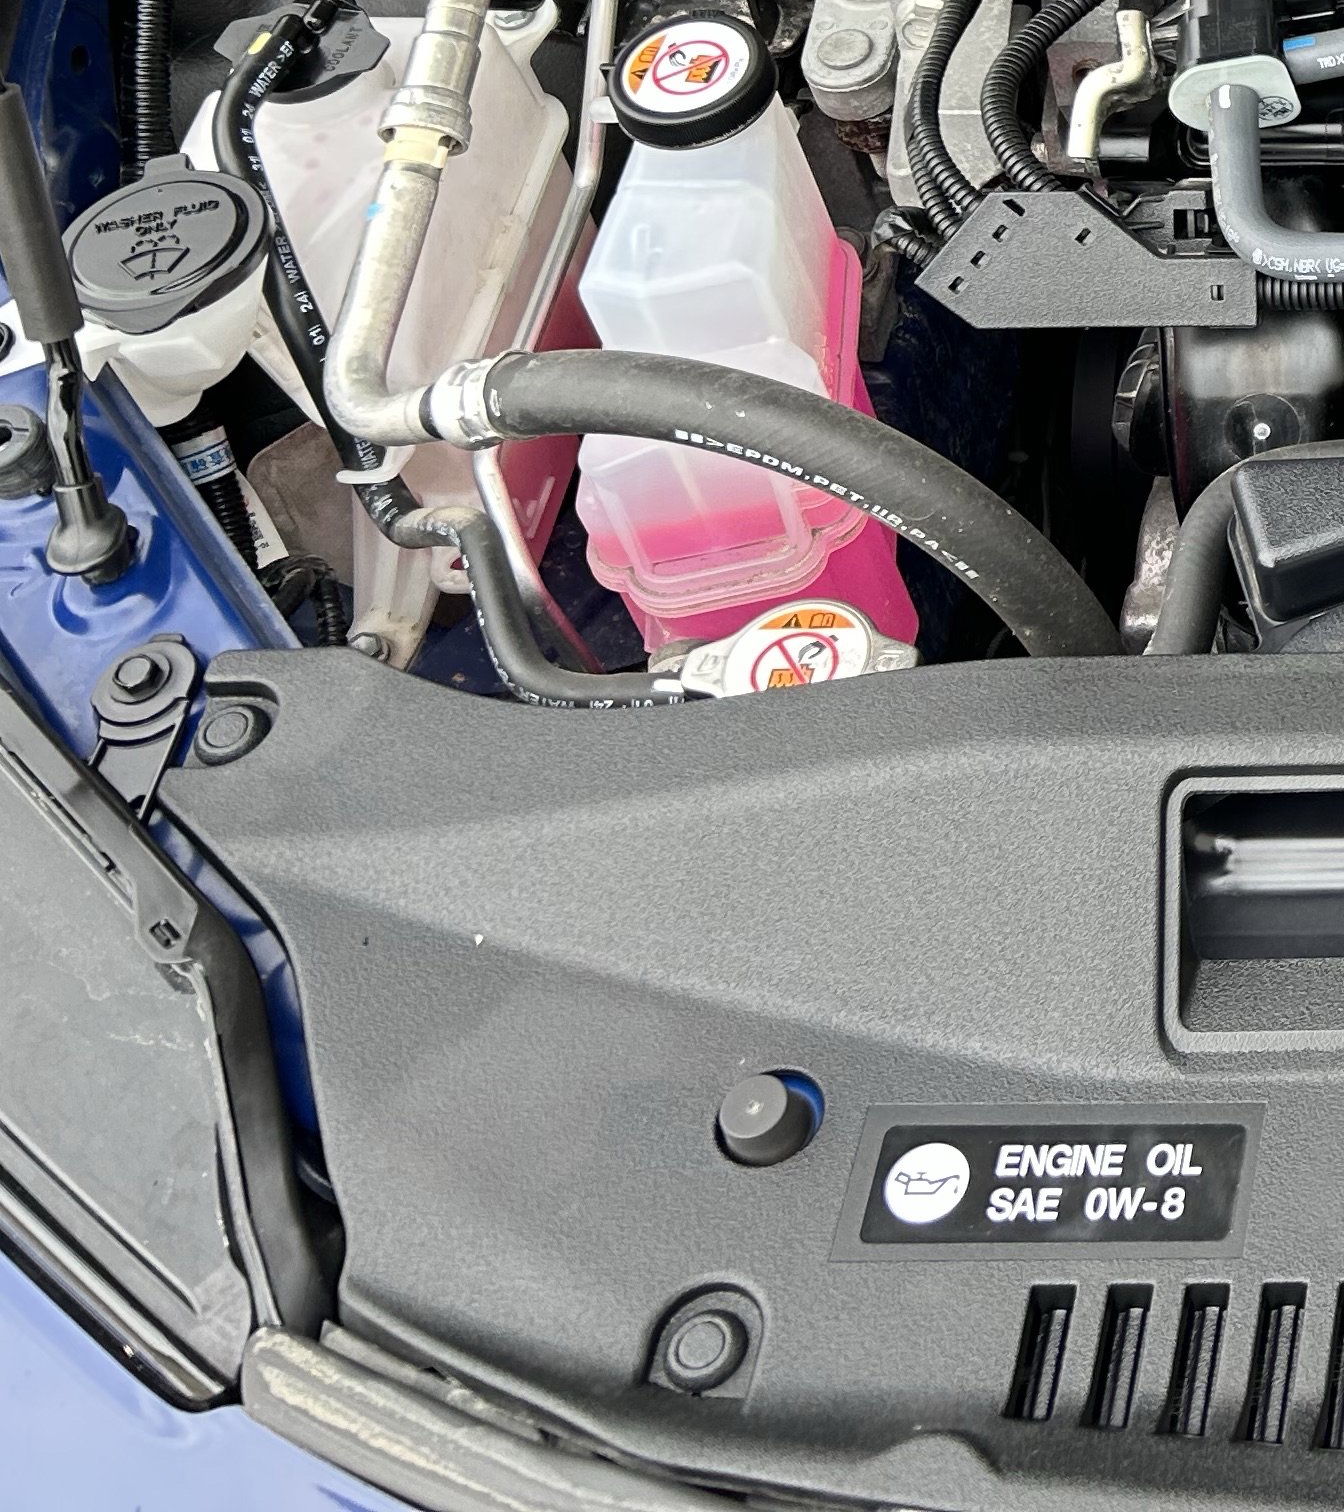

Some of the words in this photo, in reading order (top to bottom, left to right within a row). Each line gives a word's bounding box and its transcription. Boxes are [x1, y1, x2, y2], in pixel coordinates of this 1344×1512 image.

[324, 25, 363, 72] COOLANT
[248, 62, 282, 98] WATER
[94, 210, 164, 235] WASHER
[173, 199, 221, 217] FLUID
[135, 219, 178, 238] ONLY
[273, 236, 302, 284] WATER
[994, 1143, 1128, 1178] ENGINE
[1145, 1143, 1203, 1177] OIL
[985, 1186, 1063, 1222] SAE
[1083, 1186, 1186, 1221] 0W-8
